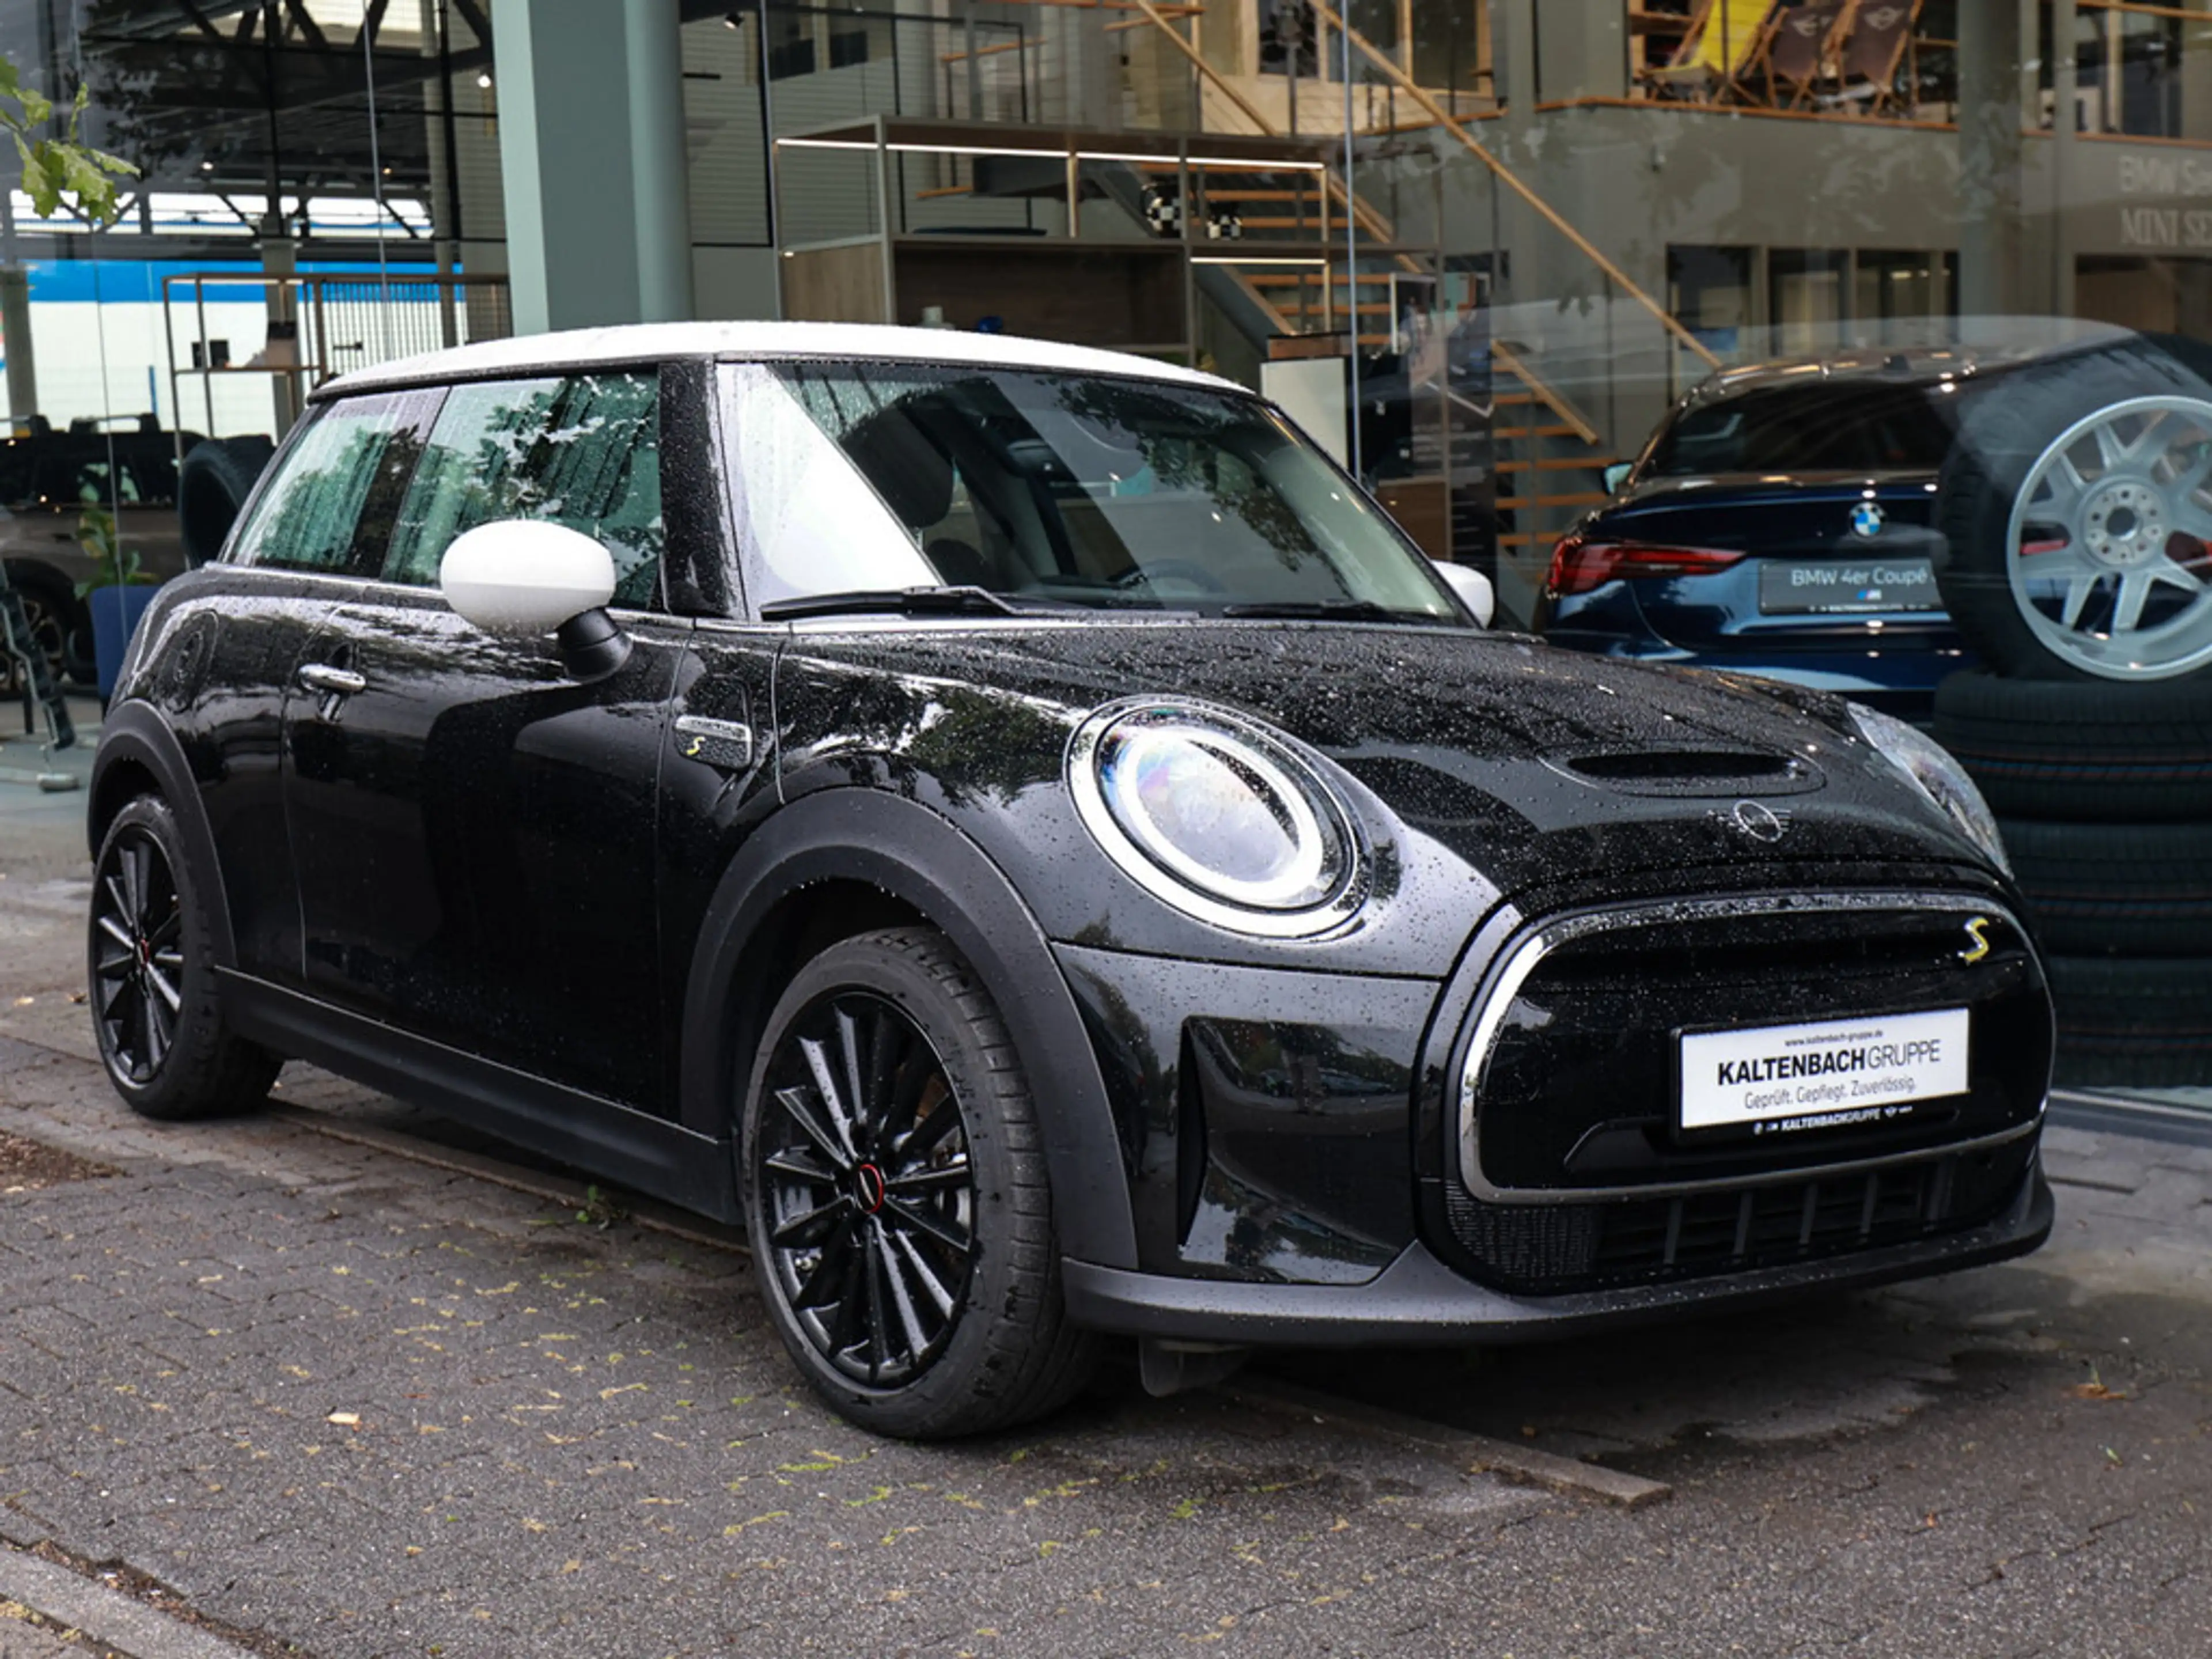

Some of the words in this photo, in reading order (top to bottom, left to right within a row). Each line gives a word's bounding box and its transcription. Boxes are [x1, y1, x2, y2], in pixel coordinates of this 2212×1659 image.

[2119, 156, 2177, 193] BMW
[2121, 208, 2178, 247] MINI
[1791, 569, 1838, 586] BMW
[1841, 569, 1869, 584] 4er
[1873, 566, 1927, 586] Coupé
[1958, 916, 1989, 965] S
